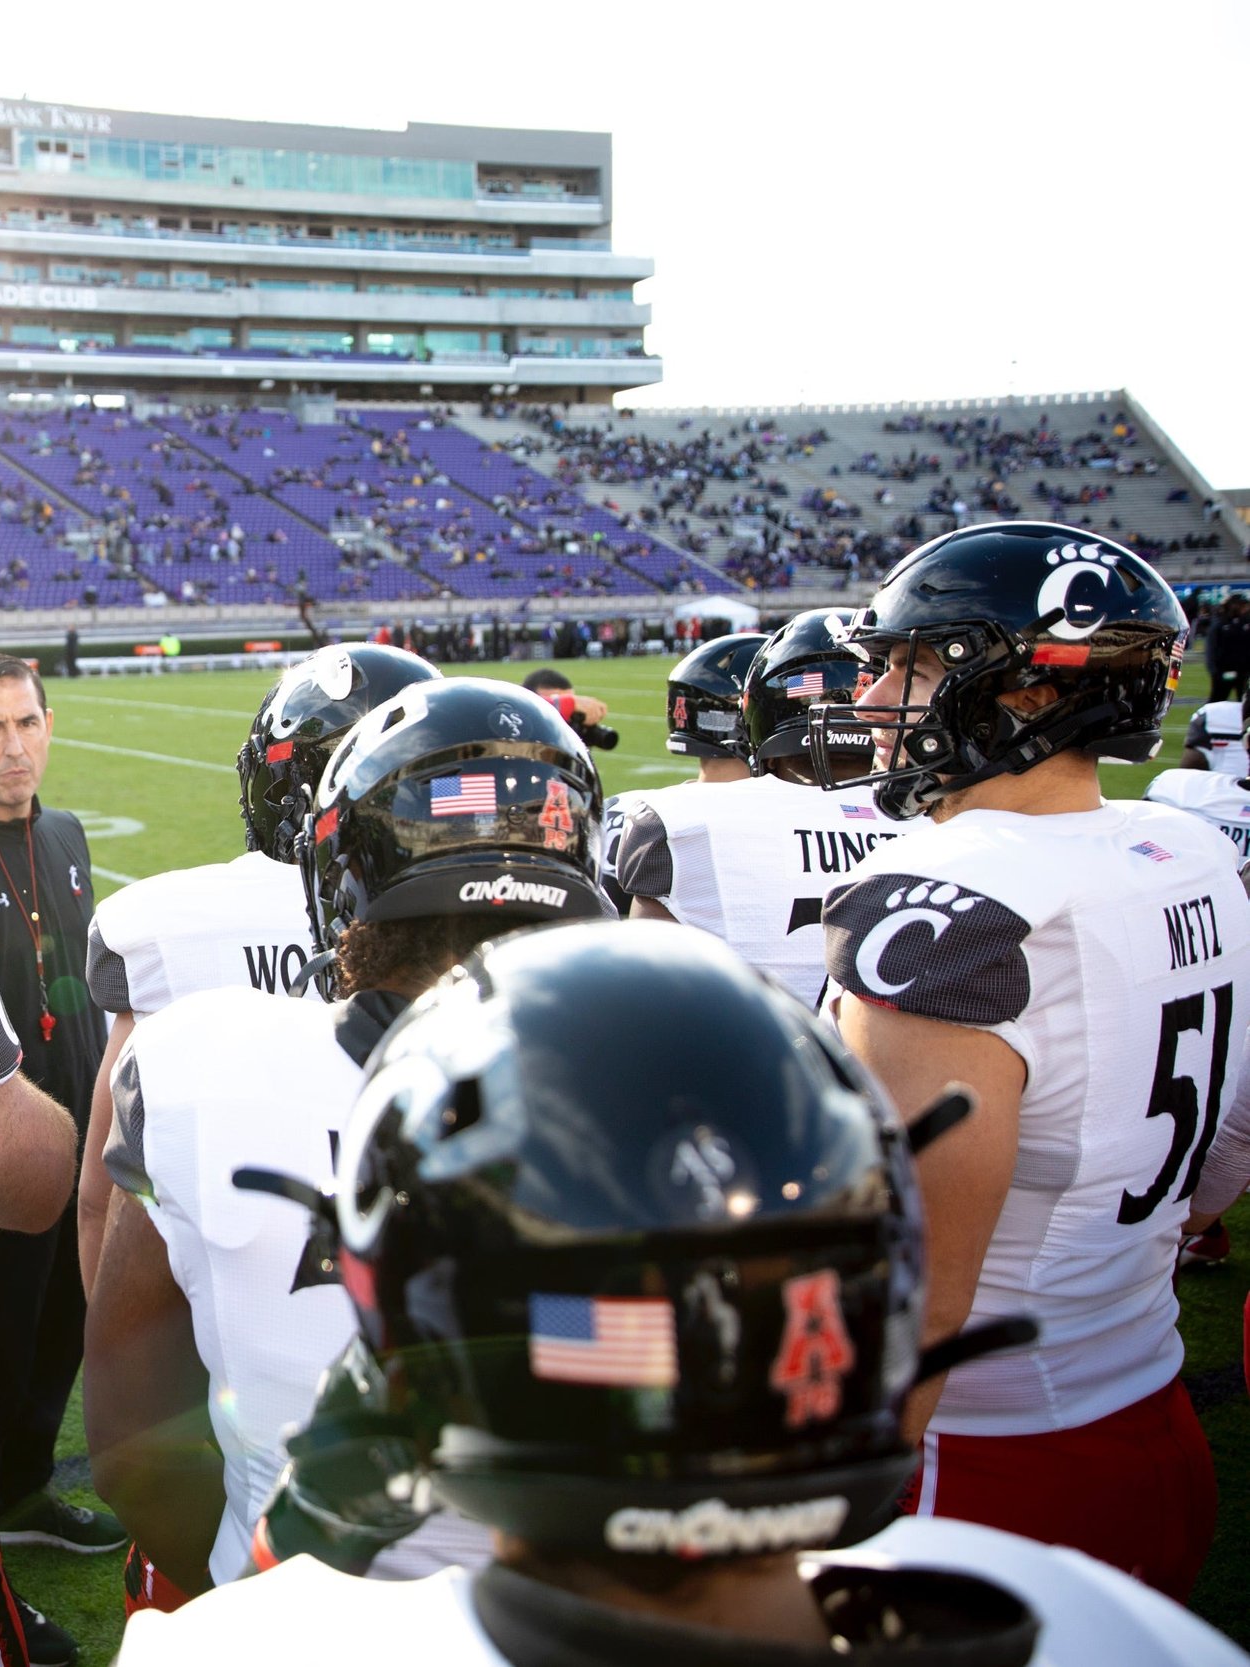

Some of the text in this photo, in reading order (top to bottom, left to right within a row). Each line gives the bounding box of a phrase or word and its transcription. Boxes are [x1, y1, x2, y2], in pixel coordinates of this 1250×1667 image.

[46, 105, 111, 133] TOWER
[38, 286, 98, 310] CLUB
[801, 730, 871, 746] CINNATI
[459, 874, 568, 908] CINCINNATI
[1163, 895, 1222, 970] METZ
[1117, 980, 1233, 1225] 51
